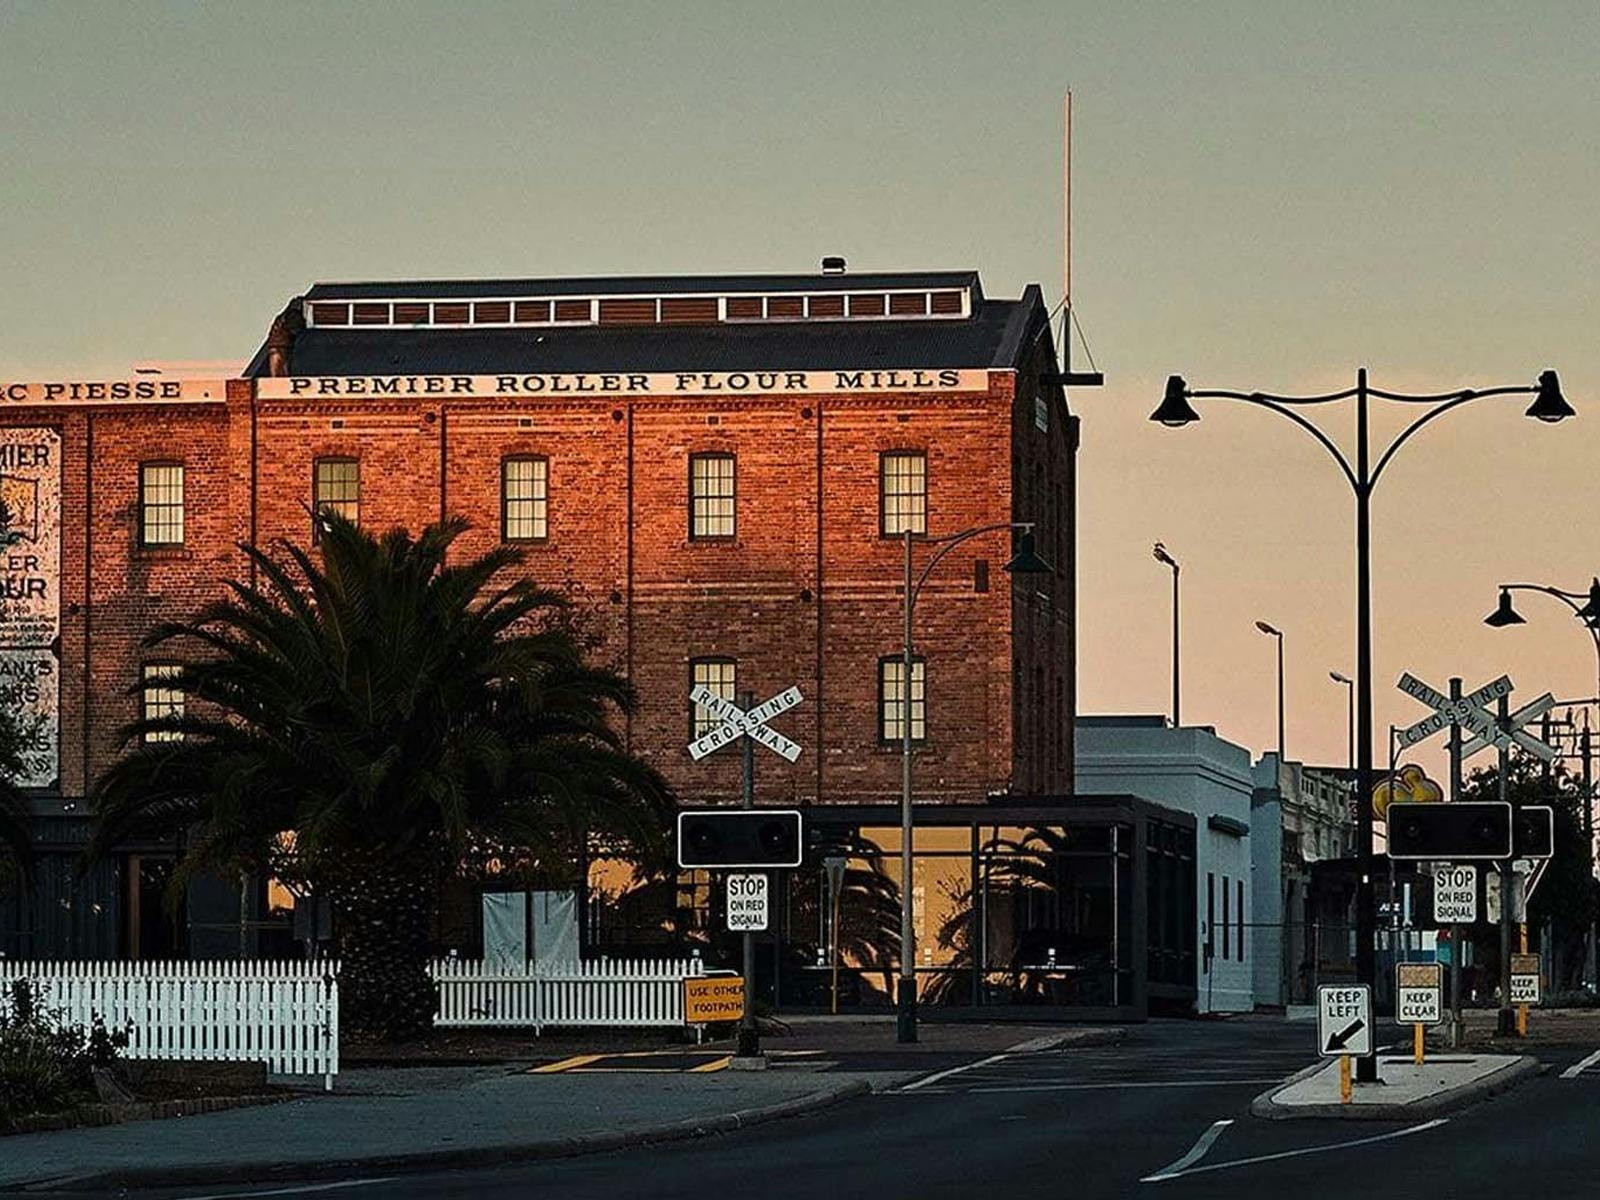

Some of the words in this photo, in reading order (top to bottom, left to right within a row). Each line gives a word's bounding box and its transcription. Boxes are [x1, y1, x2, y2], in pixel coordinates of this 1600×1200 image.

[290, 375, 474, 394] PREMIER
[496, 374, 650, 393] ROLLER
[676, 372, 808, 390] FLOUR
[836, 370, 960, 388] MILLS
[44, 381, 181, 400] PIESSE
[1405, 682, 1506, 743] CROSSING
[697, 692, 795, 754] CROSSING
[1437, 870, 1474, 887] STOP
[729, 879, 765, 896] STOP
[1437, 892, 1452, 903] ON
[1453, 892, 1473, 903] RED
[730, 901, 744, 911] ON
[745, 900, 765, 911] RED
[1437, 906, 1473, 918] SIGNAL
[730, 914, 765, 926] SIGNAL
[689, 986, 709, 997] USE
[1327, 991, 1361, 1003] KEEP
[1406, 993, 1433, 1003] KEEP
[694, 1001, 743, 1014] FOOTPATH
[1328, 1006, 1360, 1018] LEFT
[1402, 1006, 1437, 1018] CLEAR
